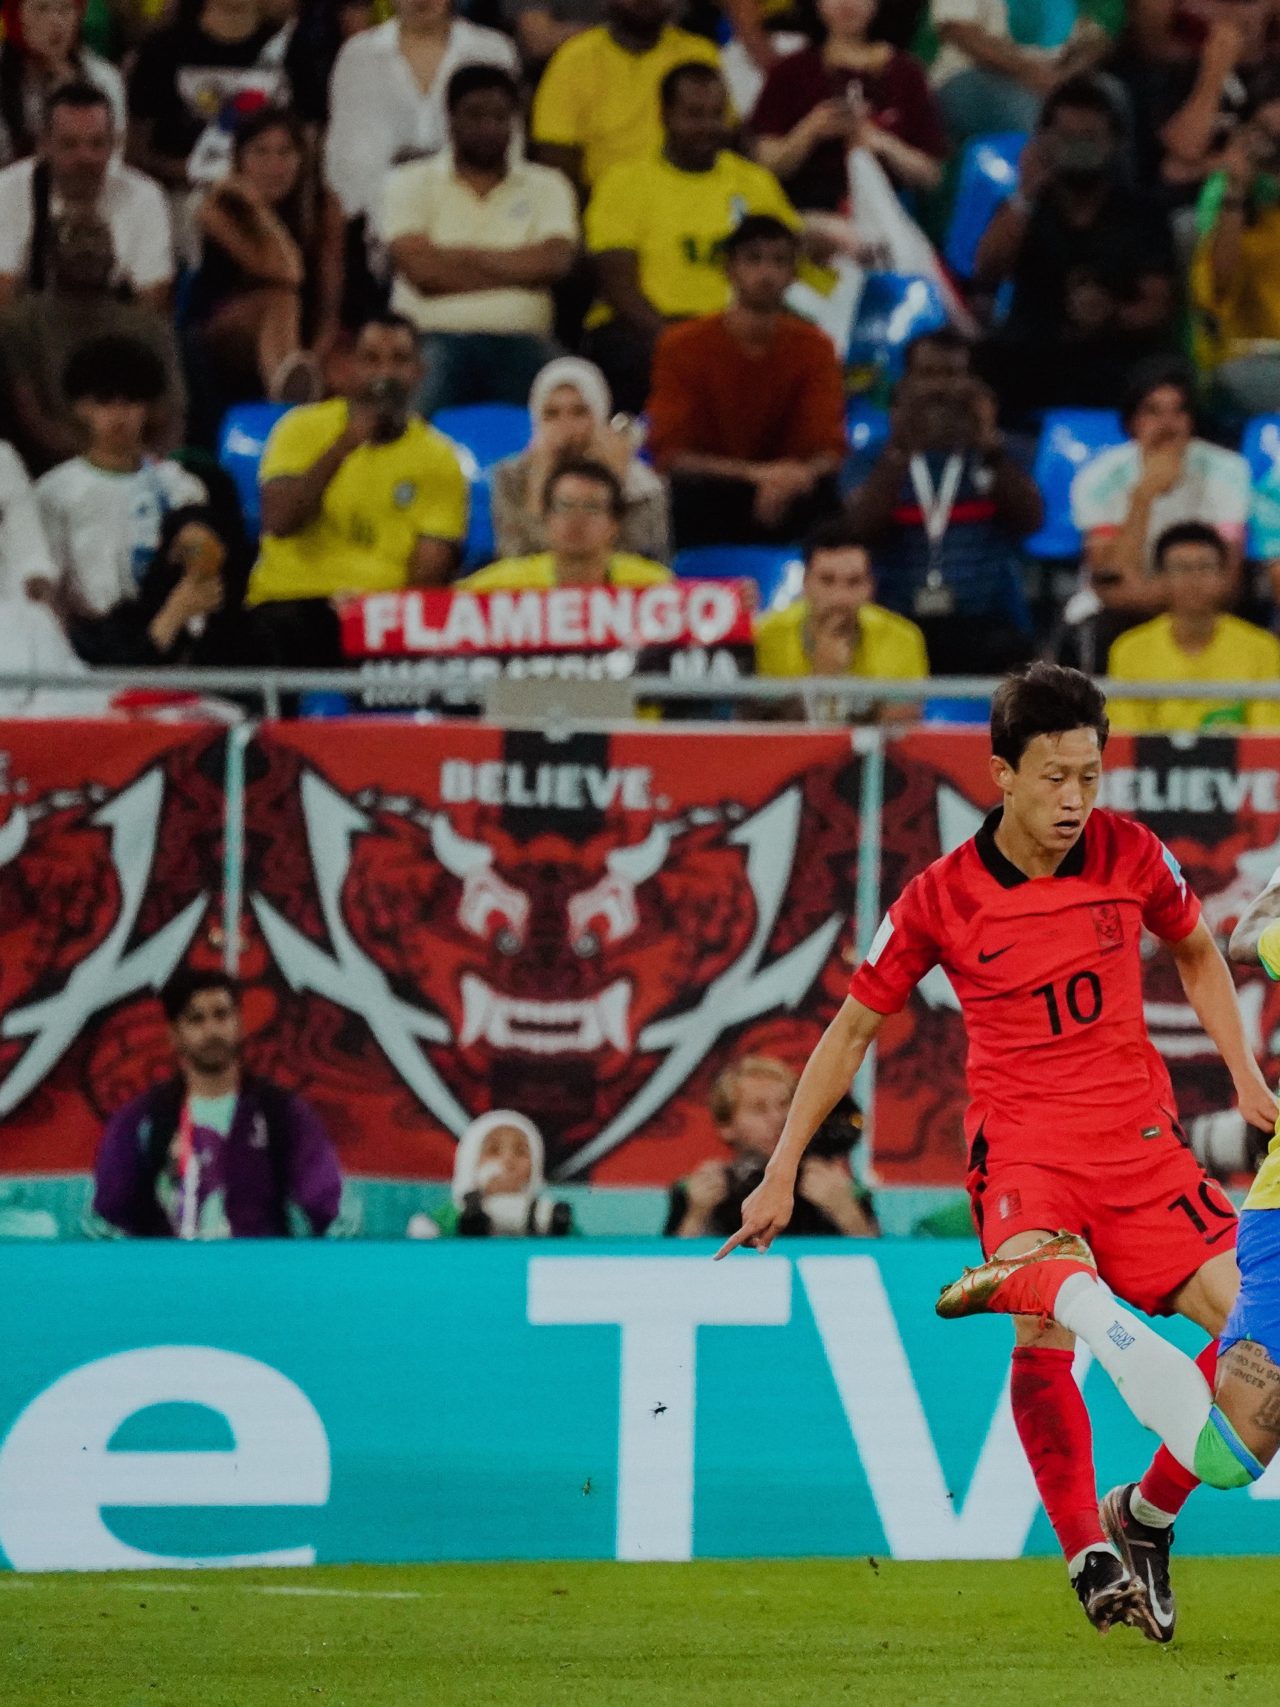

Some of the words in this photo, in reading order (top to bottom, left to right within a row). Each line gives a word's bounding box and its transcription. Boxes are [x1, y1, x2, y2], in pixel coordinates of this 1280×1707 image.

[362, 584, 738, 651] FLAMENGO
[440, 757, 671, 811] BELIEVE.
[1031, 970, 1103, 1036] 10
[1106, 1320, 1136, 1350] BRASIL
[527, 1255, 1105, 1561] TV
